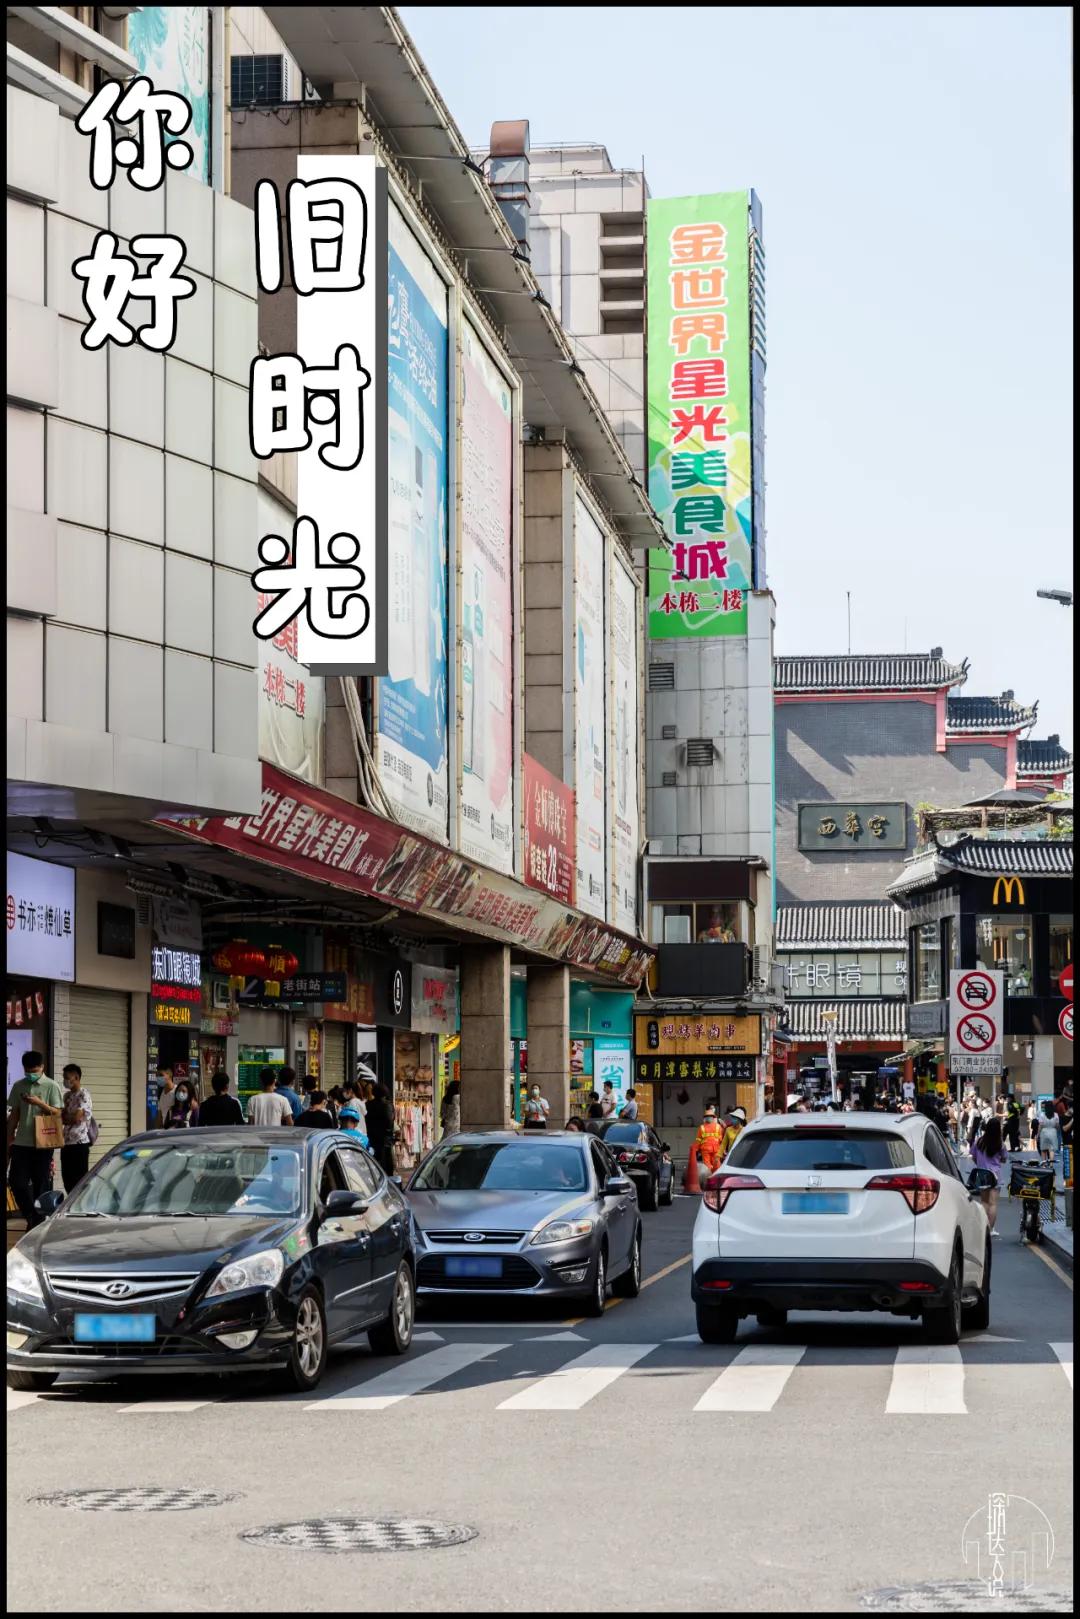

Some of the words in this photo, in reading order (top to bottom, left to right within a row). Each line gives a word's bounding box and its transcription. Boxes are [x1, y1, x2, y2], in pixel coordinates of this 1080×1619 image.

[668, 222, 729, 581] 金世界星光美食城
[658, 589, 744, 616] 本栋二楼
[262, 661, 307, 721] 本栋二楼
[283, 978, 321, 992] 老街站
[951, 1057, 1001, 1067] 东门商业步行街
